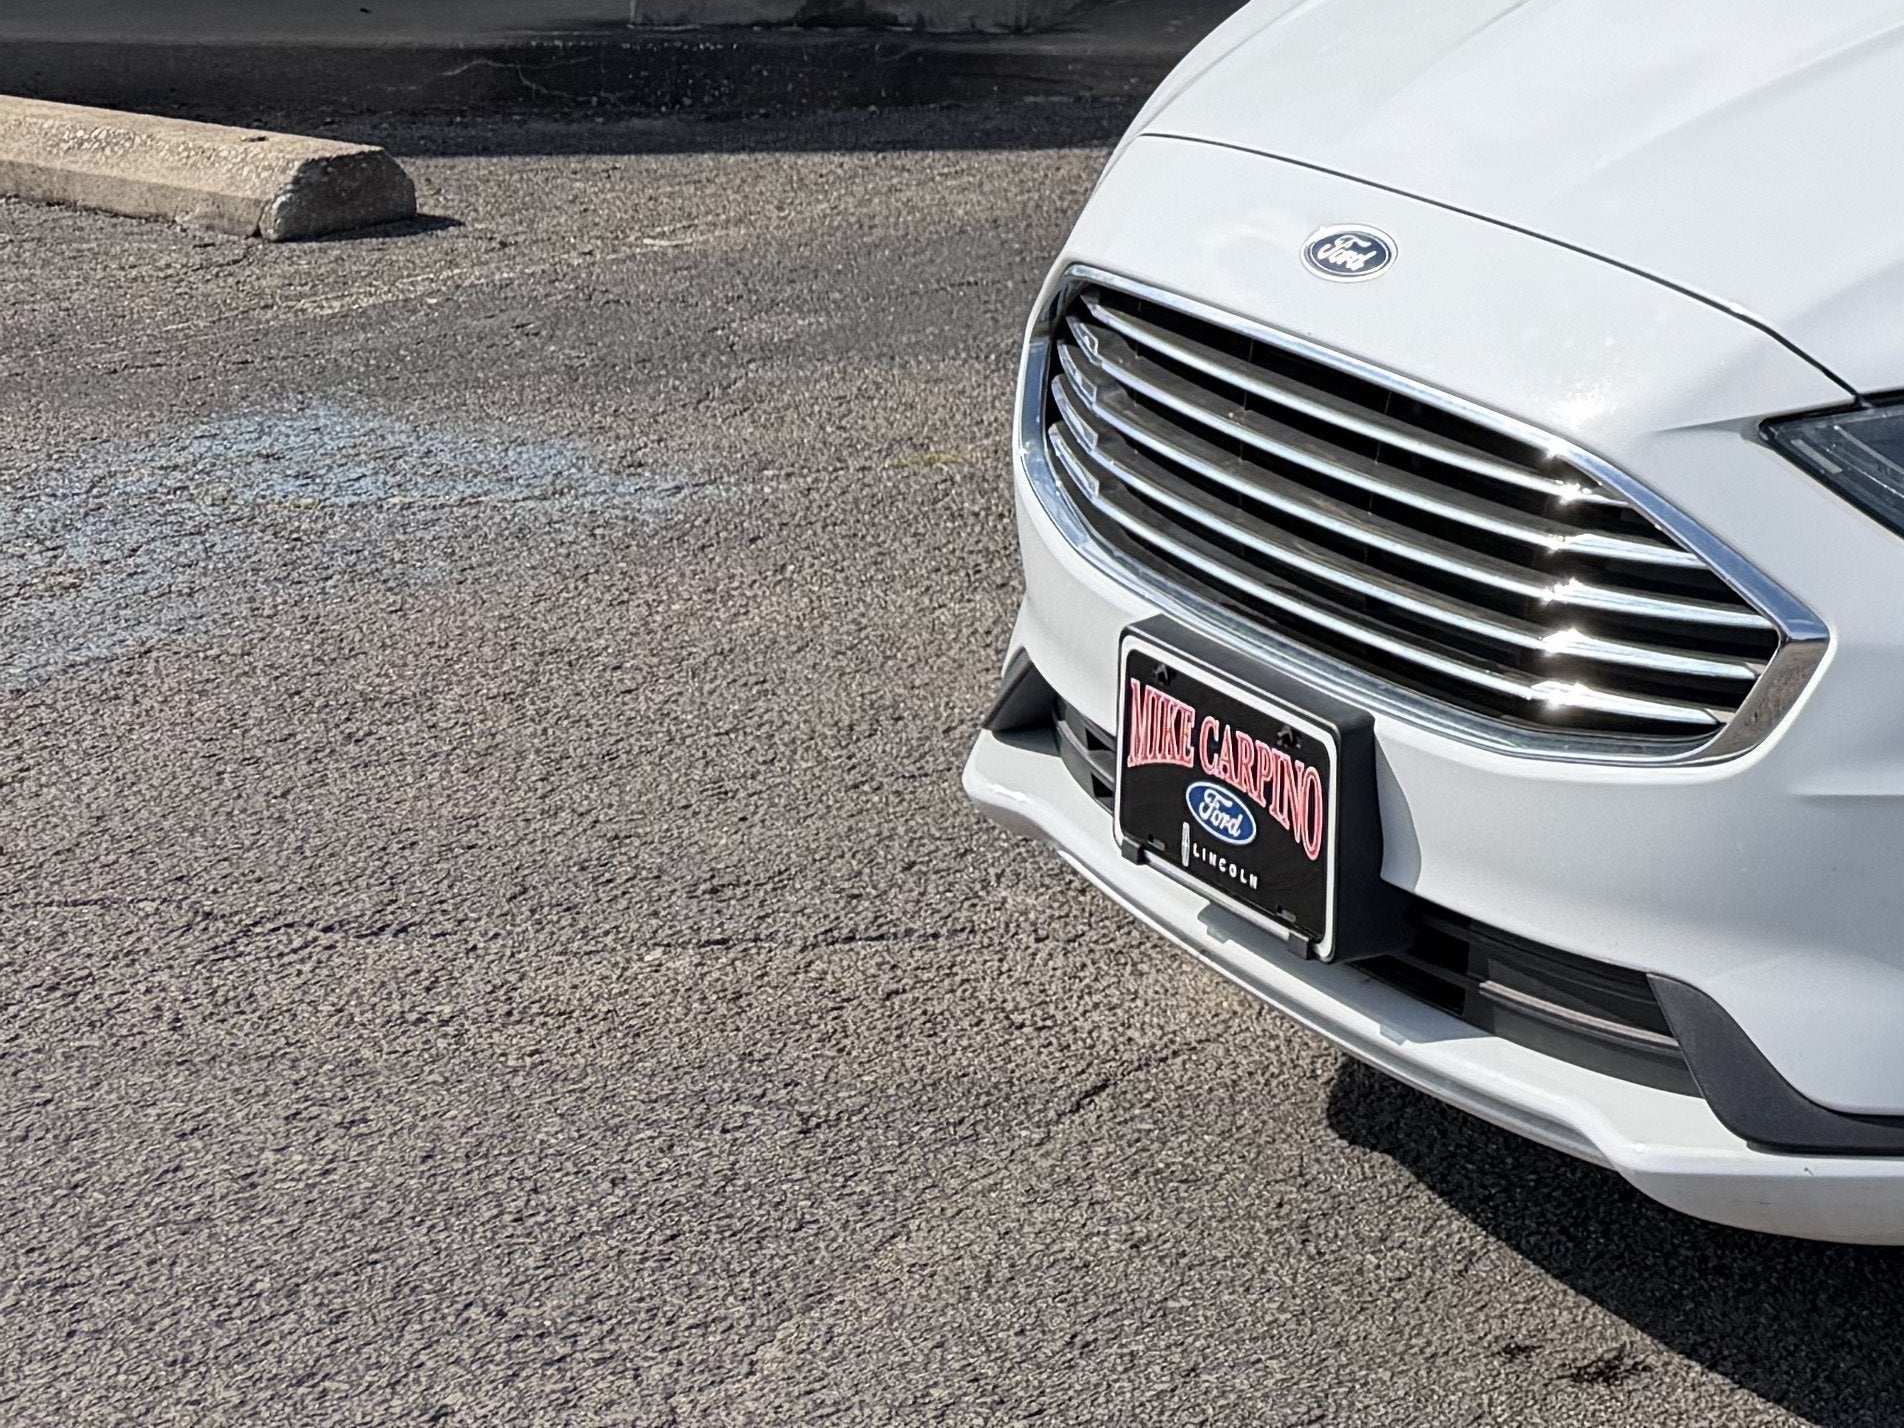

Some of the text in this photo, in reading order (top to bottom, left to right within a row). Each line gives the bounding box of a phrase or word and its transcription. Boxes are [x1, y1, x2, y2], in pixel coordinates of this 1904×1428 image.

[1317, 234, 1377, 271] Ford
[1127, 677, 1323, 861] MIKE CARPINO
[1198, 789, 1244, 838] Ford
[1192, 842, 1258, 890] LINCOLN
